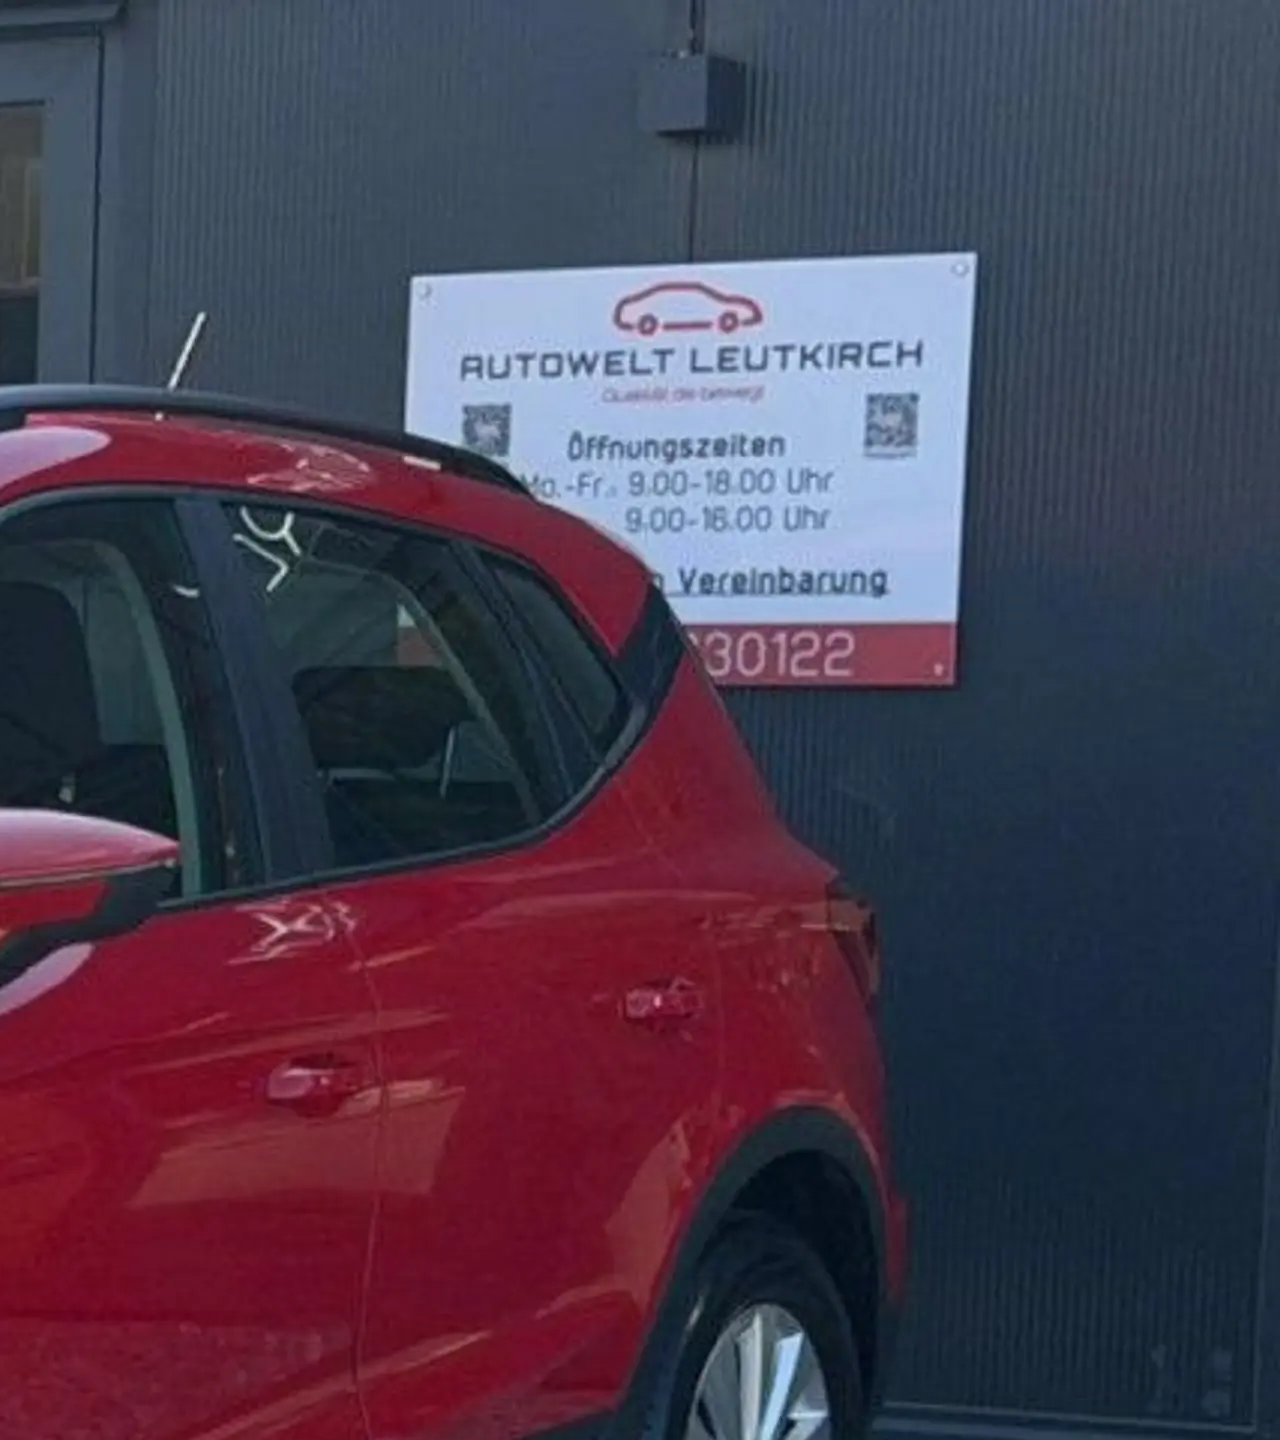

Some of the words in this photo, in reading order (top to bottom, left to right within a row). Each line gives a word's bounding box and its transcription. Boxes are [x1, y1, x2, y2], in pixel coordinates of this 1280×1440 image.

[460, 347, 675, 380] AUTOWELT
[689, 341, 924, 374] LEUTKIRCH
[566, 430, 787, 464] Öffnungszeiten
[628, 468, 777, 497] 9.00-18.00
[786, 467, 835, 496] Uhr
[783, 505, 831, 533] Uhr
[678, 565, 890, 599] Vereinbarung
[688, 630, 855, 678] 30122
